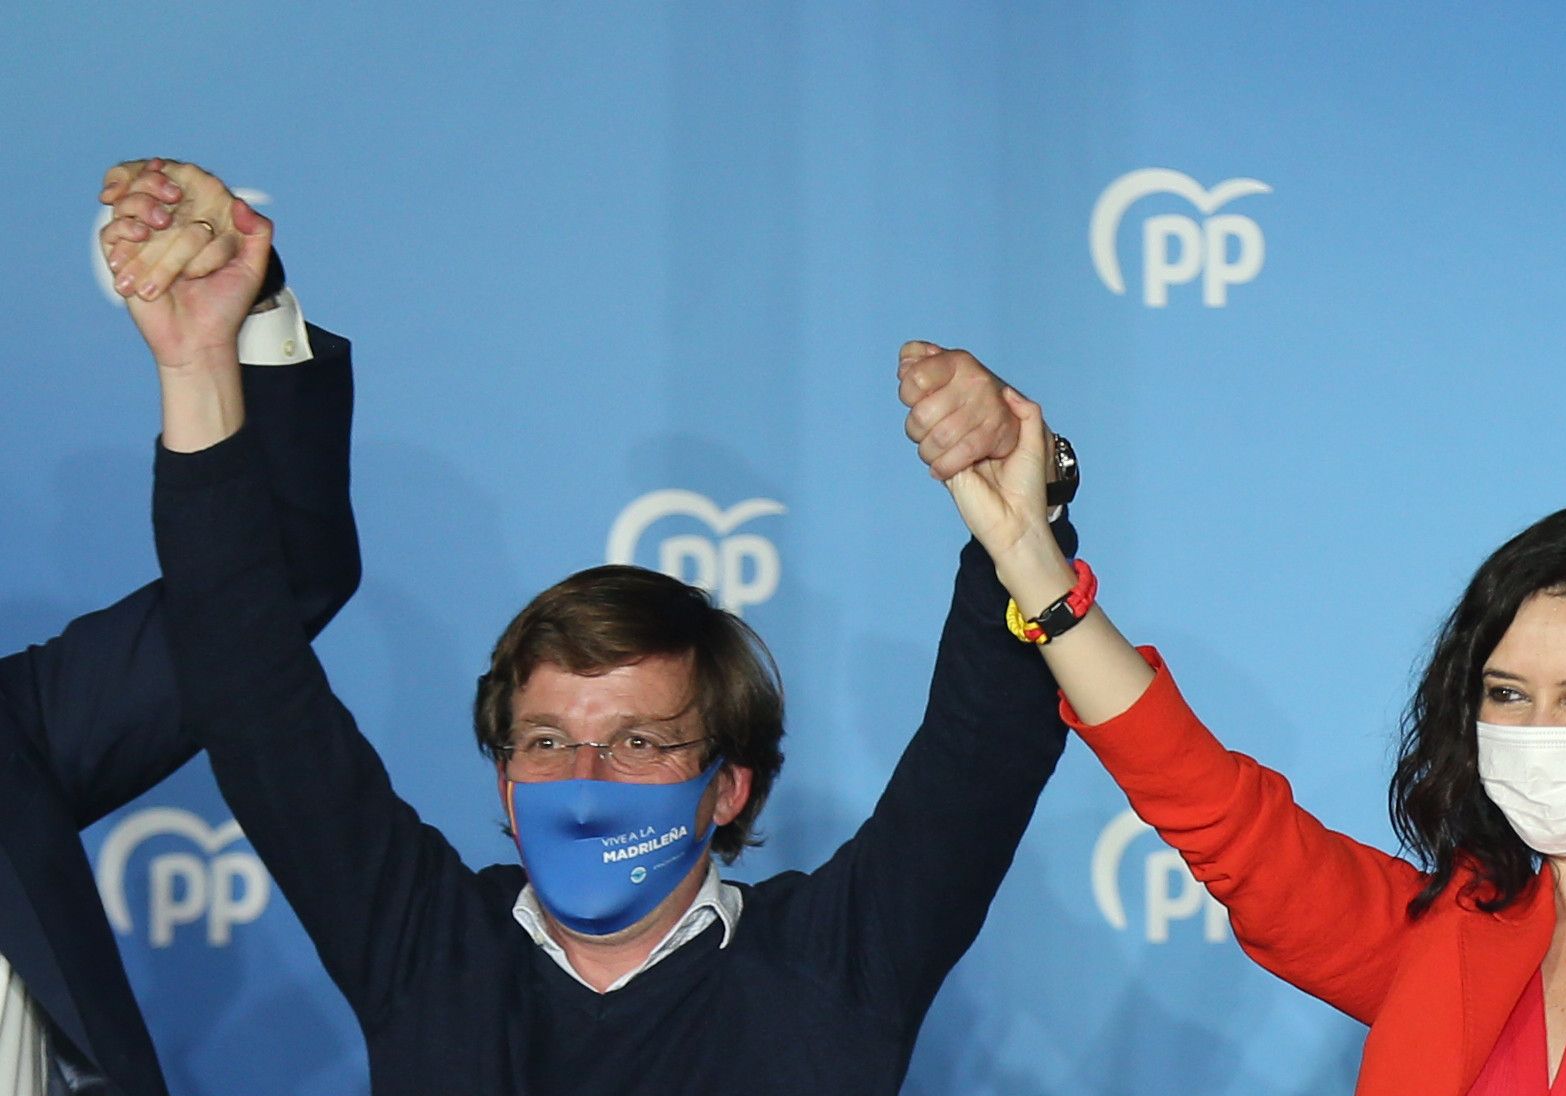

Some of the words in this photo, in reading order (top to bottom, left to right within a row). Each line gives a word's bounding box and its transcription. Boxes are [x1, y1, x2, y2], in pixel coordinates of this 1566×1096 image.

[601, 834, 627, 847] VIVE
[629, 832, 639, 841] A
[640, 826, 656, 838] LA
[603, 825, 688, 864] MADRILEÑA
